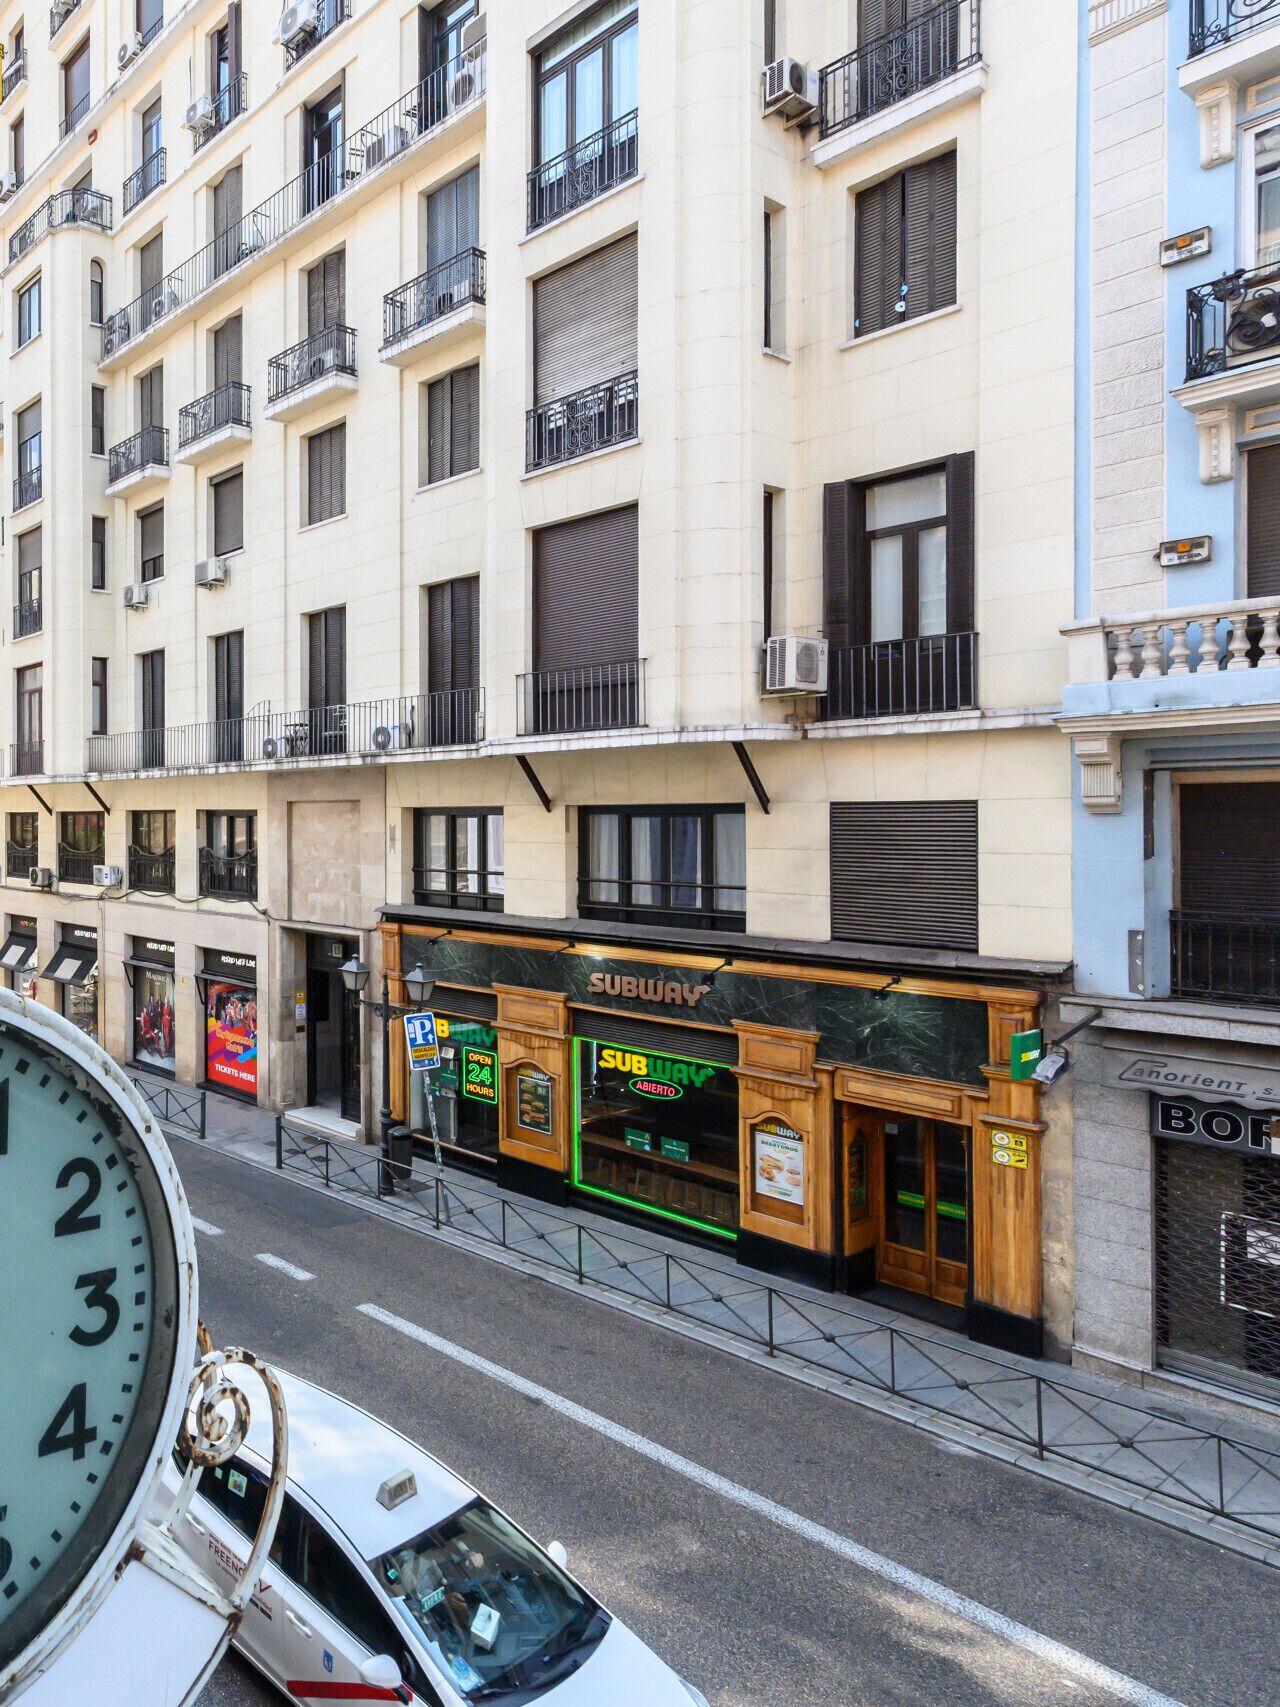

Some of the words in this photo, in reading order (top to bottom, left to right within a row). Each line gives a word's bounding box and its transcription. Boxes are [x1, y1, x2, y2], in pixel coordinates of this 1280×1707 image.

[586, 972, 712, 1007] SUBWAY
[410, 1018, 432, 1045] P
[435, 1018, 498, 1047] BWAY
[468, 1053, 492, 1065] OPEN
[1021, 1049, 1041, 1062] SUBWAY
[215, 1063, 239, 1078] TICKETS
[239, 1070, 256, 1083] HERE
[468, 1063, 492, 1085] 24
[518, 1067, 550, 1081] SUBWAY
[598, 1048, 716, 1088] SUBWAY
[466, 1083, 495, 1097] HOURS
[636, 1080, 676, 1097] ABIERTO
[756, 1122, 801, 1140] SUBWAY
[760, 1139, 799, 1153] DESAYUNOS
[54, 1157, 102, 1237] 2
[68, 1267, 119, 1347] 3
[37, 1383, 97, 1461] 4
